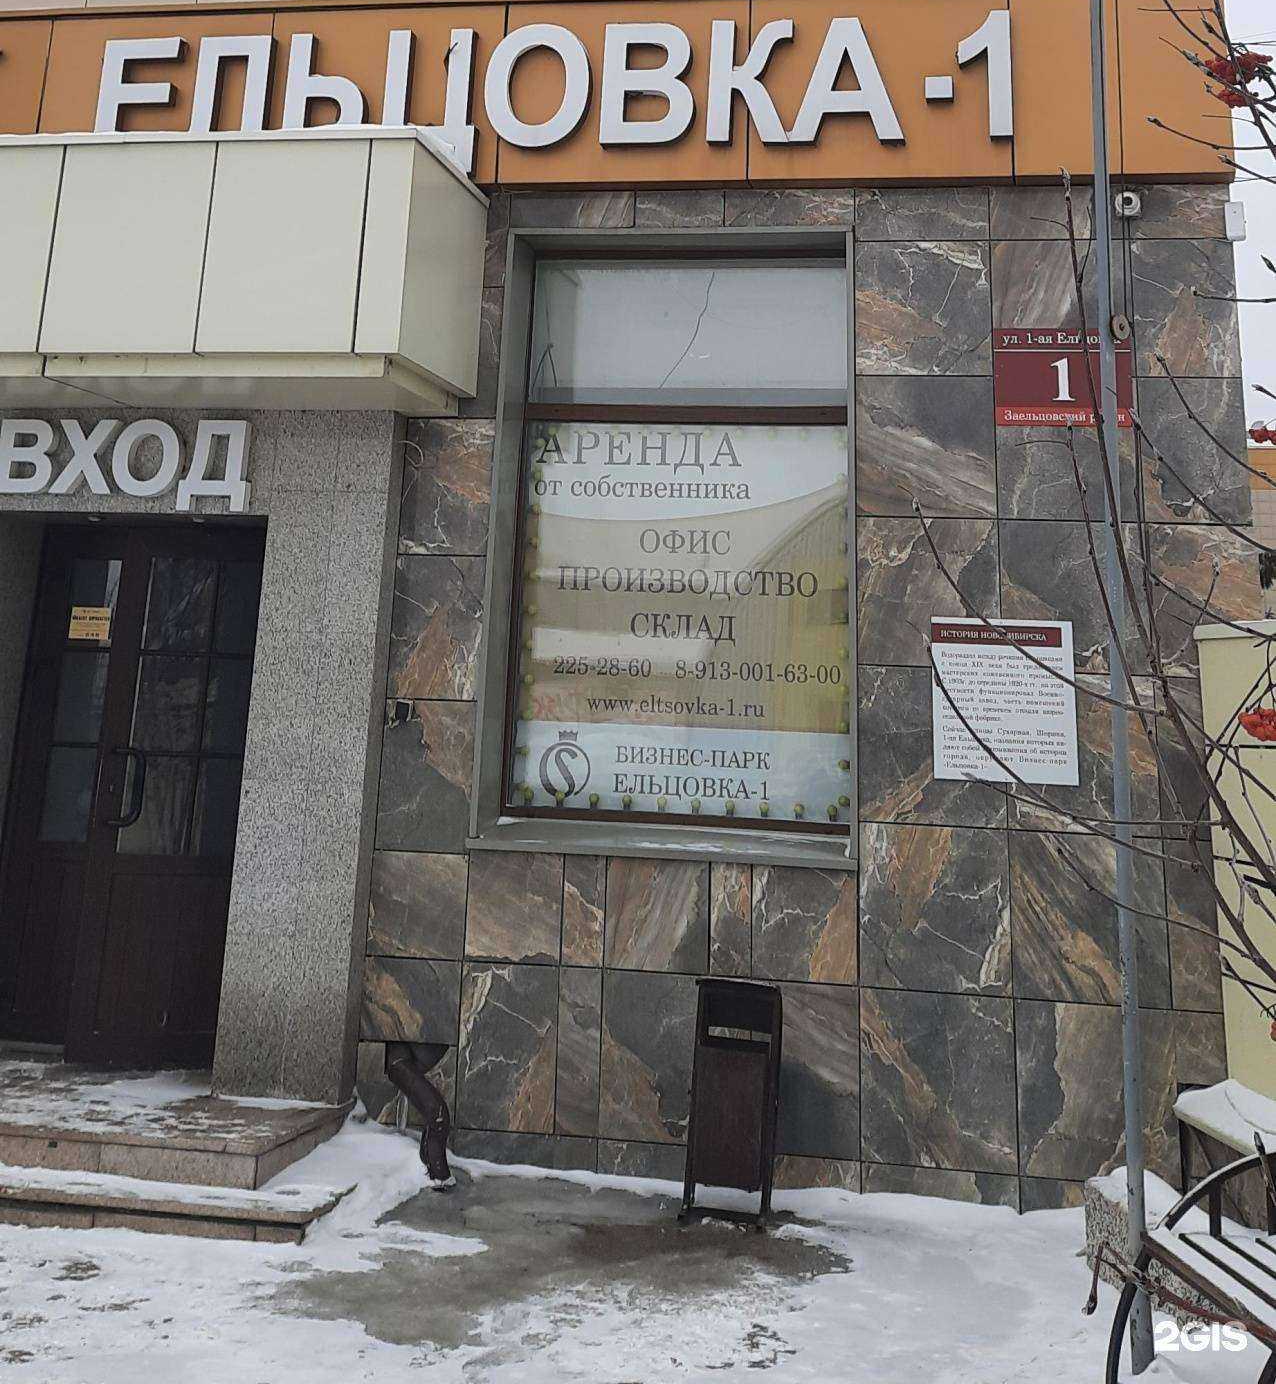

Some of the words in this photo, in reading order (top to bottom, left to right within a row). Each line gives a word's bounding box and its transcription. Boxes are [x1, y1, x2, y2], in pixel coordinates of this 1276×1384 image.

[1002, 335, 1022, 347] ул.
[1027, 333, 1052, 344] 1-ая
[1050, 357, 1076, 402] 1
[0, 419, 250, 512] ВХОД
[536, 430, 743, 475] АРЕНДА
[535, 480, 563, 496] от
[570, 475, 751, 501] собственника
[639, 528, 731, 556] ОФИС
[556, 566, 819, 601] ПРОИЗВОДСТВО
[630, 613, 736, 647] СКЛАД
[940, 629, 979, 639] ИСТОРИЯ
[552, 655, 652, 678] 225-28-60
[675, 661, 841, 685] 8-913-001-63-00
[587, 695, 765, 718] www.eltsovka-1.ru
[615, 745, 771, 770] БИЗНЕС-ПАРК
[613, 773, 770, 801] ЕЛЬЦОВКА-1
